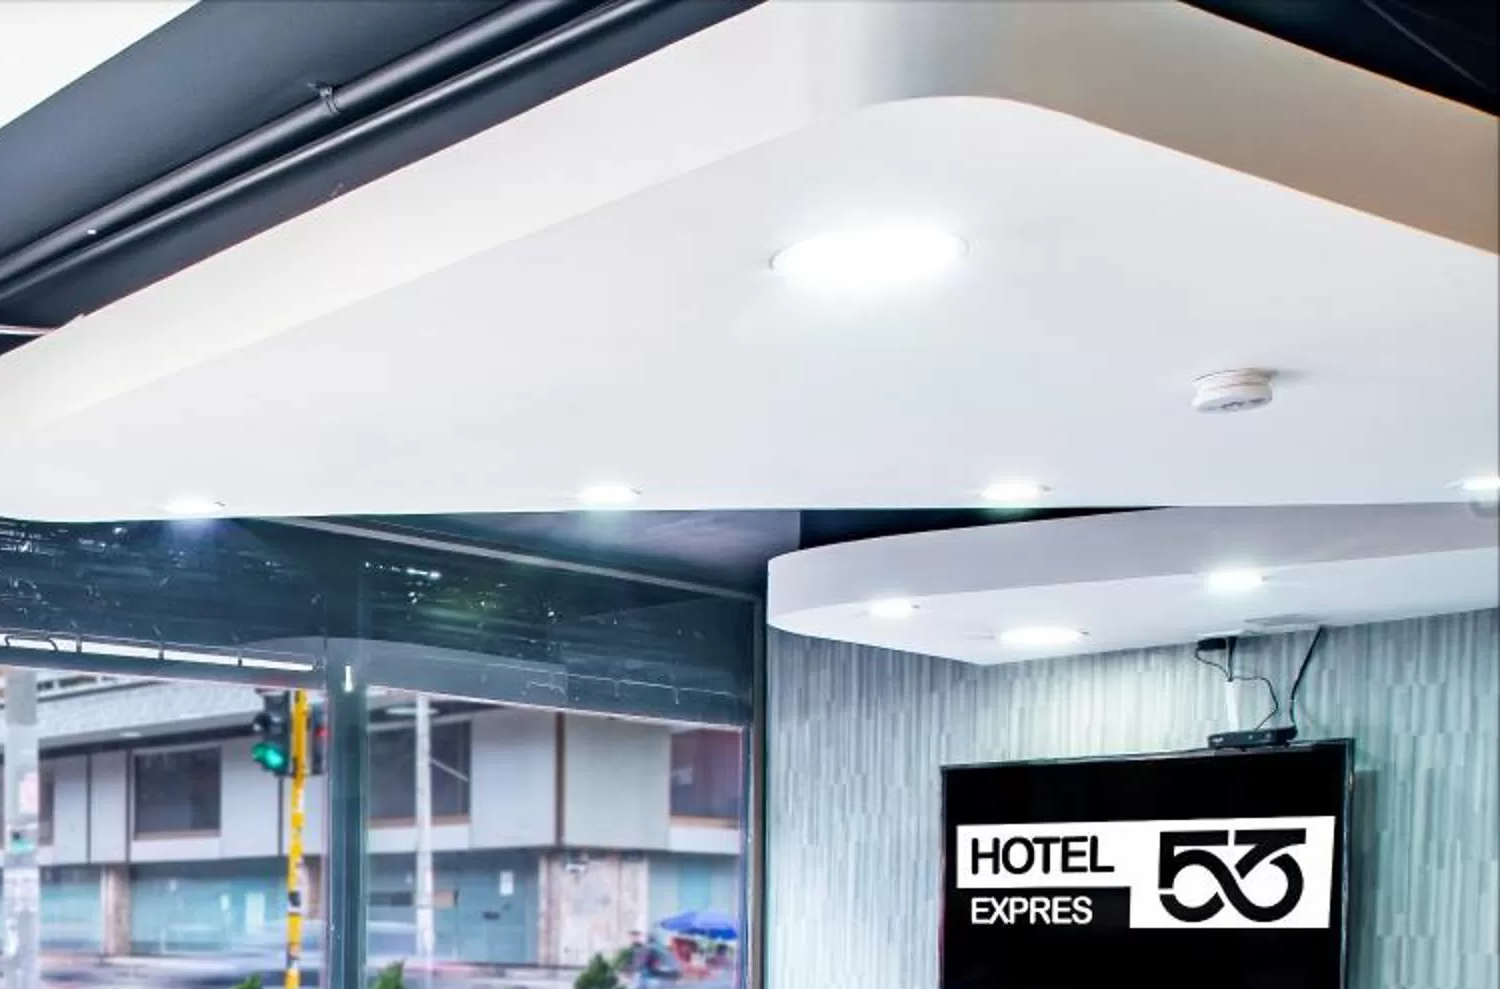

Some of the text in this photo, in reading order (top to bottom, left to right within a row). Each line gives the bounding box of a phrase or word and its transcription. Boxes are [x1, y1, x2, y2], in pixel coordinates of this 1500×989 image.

[970, 828, 1307, 923] HOTEL 53
[970, 896, 1093, 925] EXPRES
